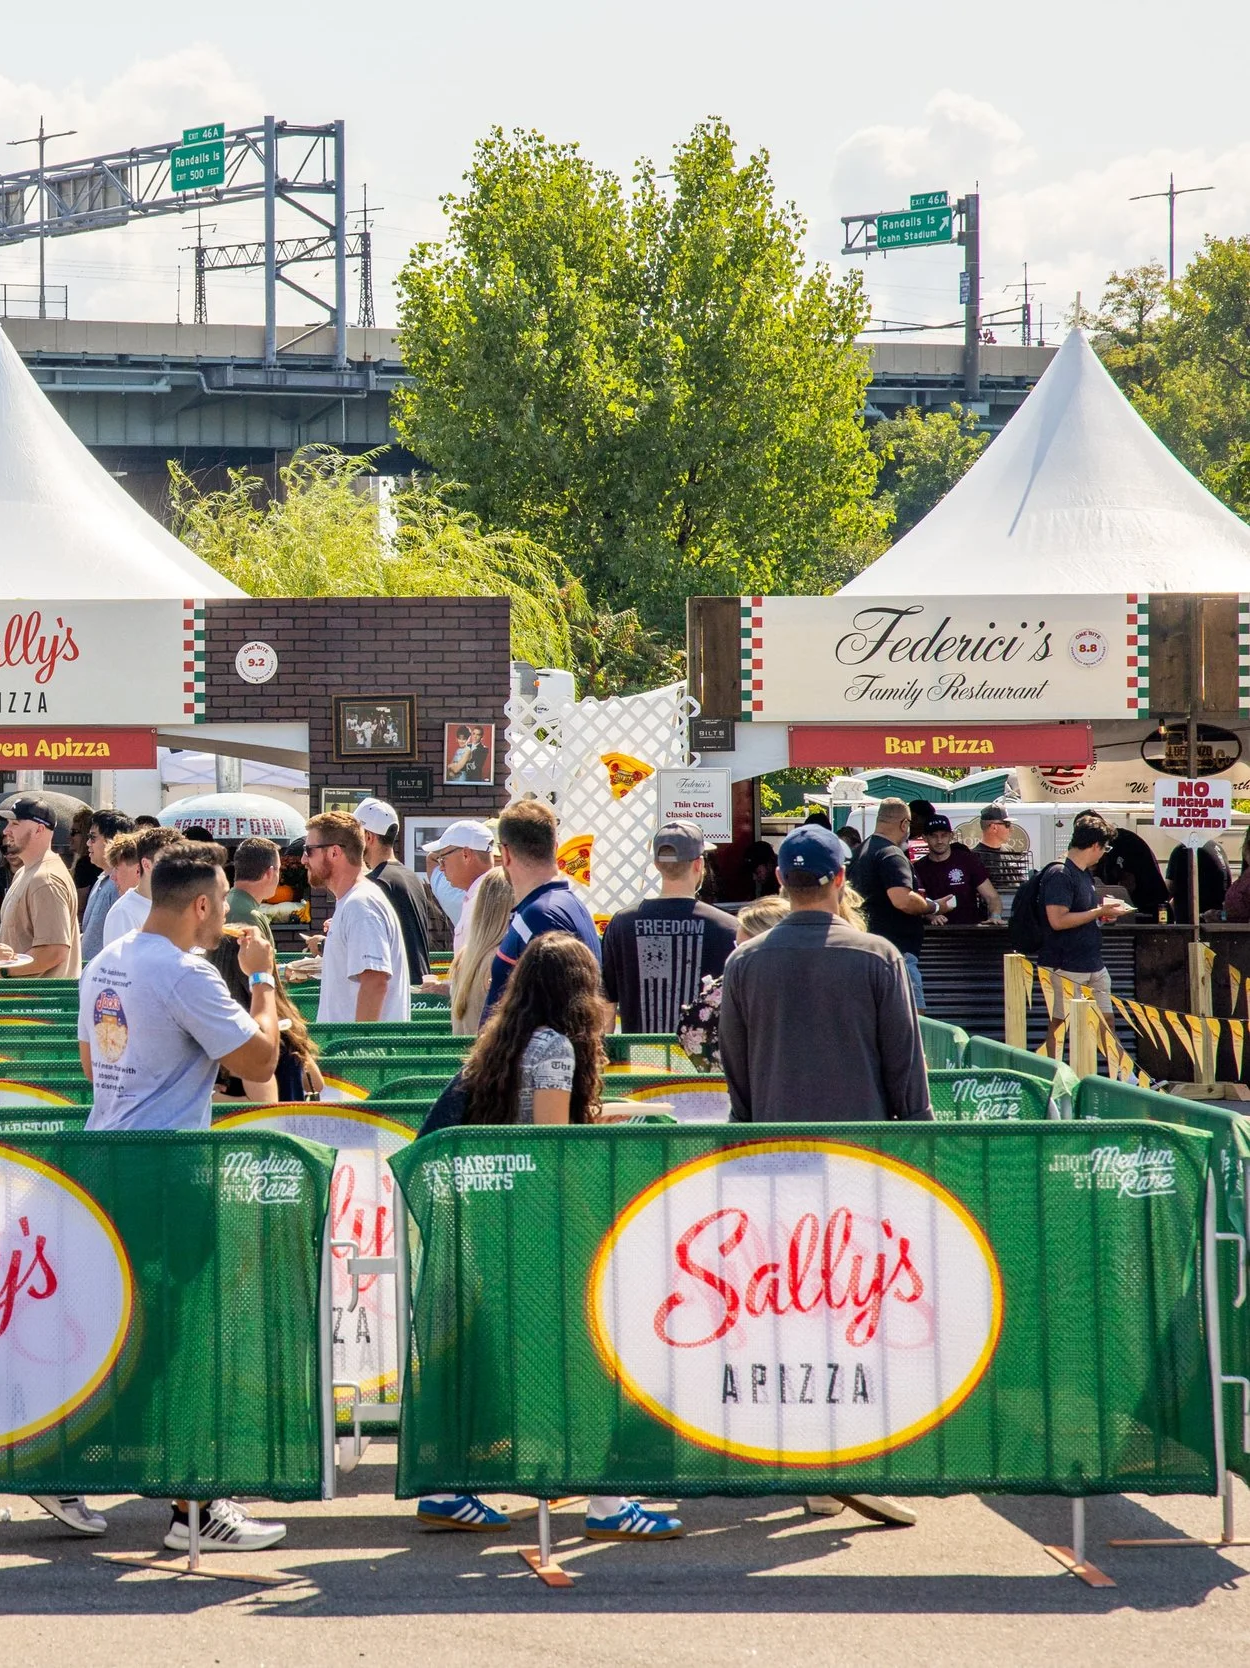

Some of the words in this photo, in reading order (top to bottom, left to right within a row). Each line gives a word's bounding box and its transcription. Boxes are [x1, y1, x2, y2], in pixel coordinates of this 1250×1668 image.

[188, 132, 198, 140] EXIT
[202, 127, 219, 138] 46A
[175, 153, 209, 167] Randalls
[213, 151, 220, 160] Is
[176, 173, 186, 181] EXIT
[190, 168, 204, 180] 500
[207, 167, 219, 175] FEET
[911, 198, 925, 206] EXIT
[927, 194, 946, 204] 46A
[882, 217, 921, 230] Randalls
[927, 215, 935, 224] Is
[879, 234, 900, 243] Icahn
[904, 230, 936, 240] Stadium
[835, 604, 1053, 666] Federici's
[1075, 631, 1088, 640] ONE
[1088, 630, 1102, 640] BITE
[243, 645, 255, 654] ONE
[256, 645, 270, 654] BITE
[1078, 643, 1098, 653] 8.8
[247, 658, 266, 667] 9.2
[843, 673, 924, 711] Family
[926, 671, 1050, 703] Restaurant
[36, 738, 111, 761] Apizza
[884, 735, 926, 755] Bar
[931, 734, 995, 755] Pizza
[1040, 780, 1086, 795] INTEGRITY
[1177, 781, 1210, 798] NO
[673, 800, 691, 809] Thin
[692, 801, 714, 809] Crust
[1161, 797, 1224, 808] HINGHAM
[665, 810, 693, 818] Classic
[1177, 808, 1209, 818] KIDS
[1159, 818, 1227, 829] ALLOWED!
[634, 918, 706, 936] FREEDOM
[952, 1075, 1023, 1103] Medium
[976, 1098, 1021, 1120] Rare
[224, 1151, 304, 1180] Medium
[453, 1154, 537, 1173] BARSTOOL
[1091, 1144, 1176, 1175] Medium
[248, 1177, 303, 1204] Rare
[454, 1173, 514, 1192] SPORTS
[1117, 1169, 1177, 1199] Rare
[654, 1205, 924, 1349] Sally's
[720, 1362, 871, 1405] APIZZA
